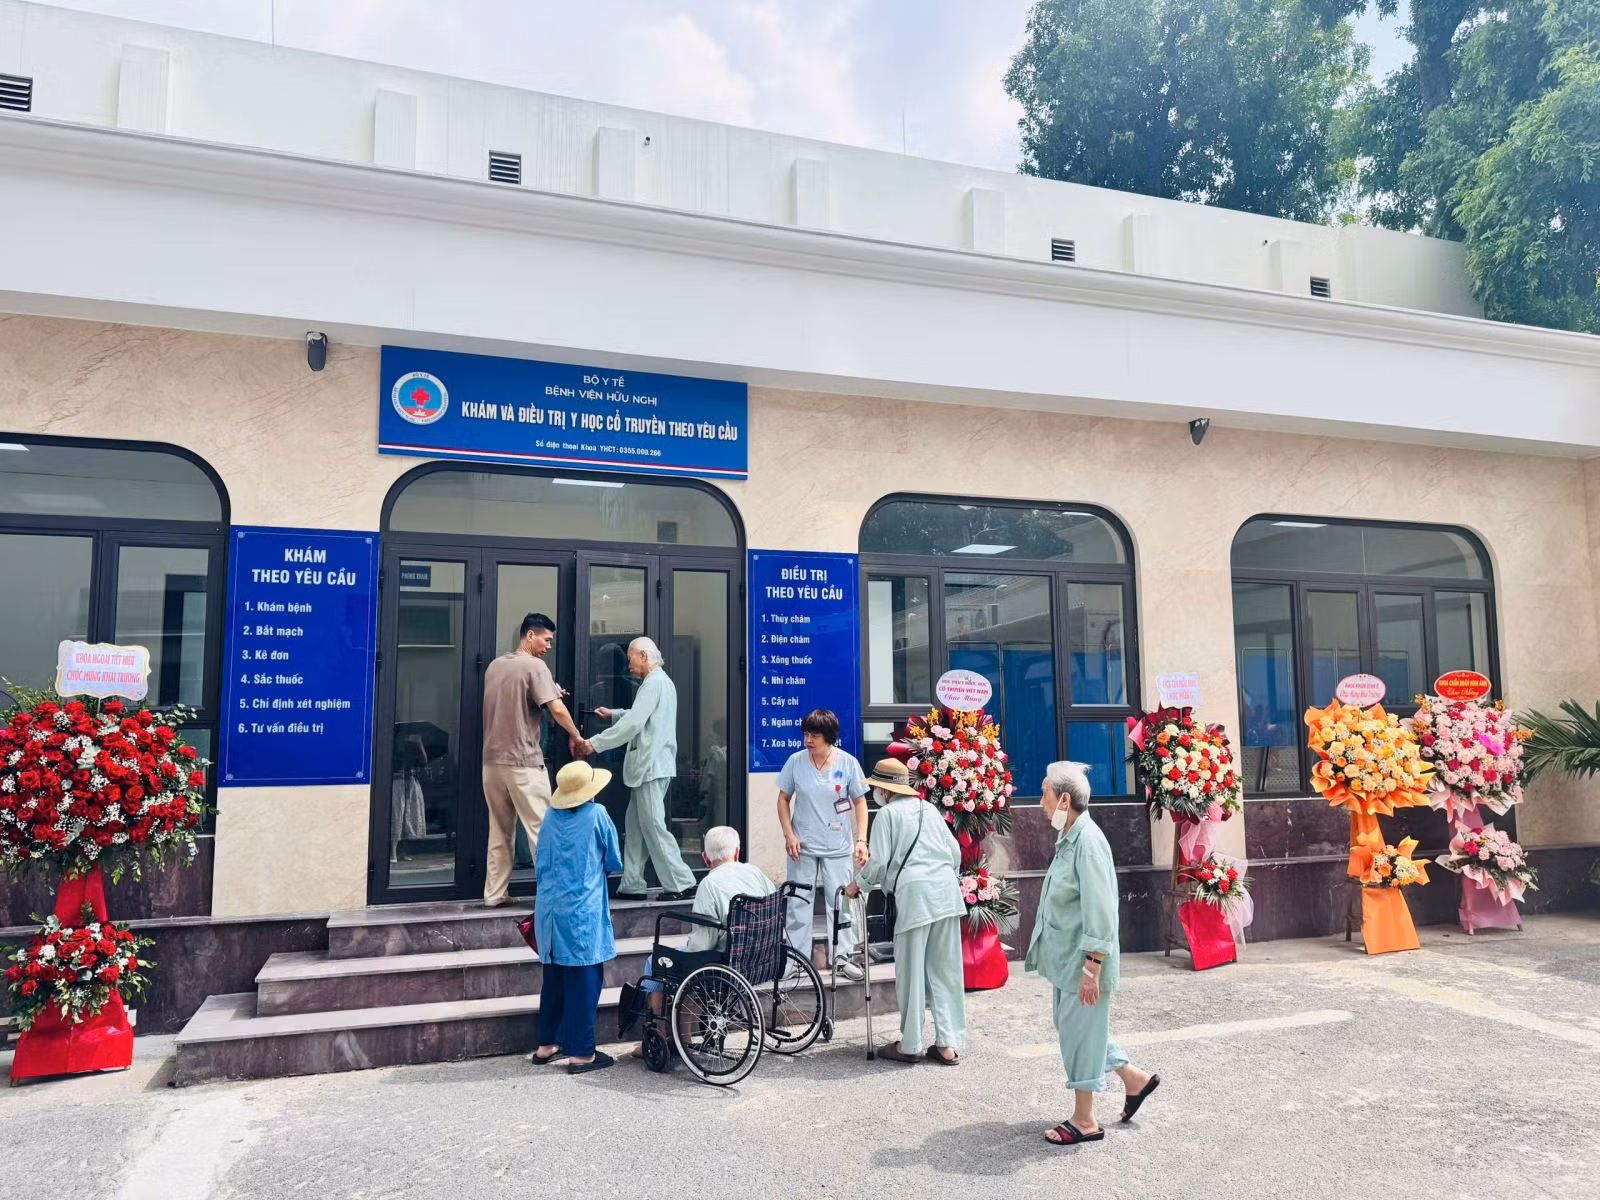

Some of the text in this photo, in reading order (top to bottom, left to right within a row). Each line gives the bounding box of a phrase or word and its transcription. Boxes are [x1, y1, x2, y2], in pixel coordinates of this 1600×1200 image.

[583, 374, 625, 388] BỘ Y TẾ
[545, 385, 657, 407] BỆNH VIỆN HỮU NGHỊ
[462, 400, 497, 420] KHÁM
[501, 403, 515, 422] VÀ
[518, 402, 544, 424] ĐIỀU
[548, 410, 566, 430] TRỊ
[571, 412, 578, 428] Y
[581, 413, 603, 433] HỌC
[606, 409, 621, 432] CỔ
[625, 414, 666, 436] TRUYỀN
[669, 421, 694, 438] THEO
[697, 421, 716, 440] YÊU
[718, 420, 738, 441] CẦU
[535, 440, 544, 448] Số
[546, 441, 560, 450] điện
[562, 443, 579, 452] thoại
[581, 444, 597, 452] Khoa
[284, 546, 327, 563] KHÁM
[252, 567, 356, 586] THEO YÊU CẦU
[781, 564, 827, 584] ĐIỀU TRỊ
[765, 584, 843, 600] THEO YÊU CẦU
[245, 601, 312, 614] 1. Khám bệnh
[761, 614, 769, 623] 1.
[790, 614, 811, 624] châm
[243, 624, 304, 638] 2. Bắt mạch
[761, 634, 810, 645] 2. Điện châm
[242, 650, 289, 660] 3. Kê đơn
[761, 655, 813, 665] 3. Xông thuốc
[240, 673, 304, 685] 4. Sắc thuốc
[761, 676, 769, 685] 4.
[785, 676, 806, 685] châm
[239, 698, 351, 710] 5. Chỉ định xét nghiệm
[761, 697, 769, 706] 5.
[771, 695, 786, 707] Cấy
[238, 721, 324, 735] 6. Tư vấn điều trị
[761, 718, 769, 727] 6.
[771, 717, 793, 728] Ngâm
[762, 739, 769, 748] 7.
[771, 739, 786, 748] Xoa
[788, 738, 802, 749] bóp
